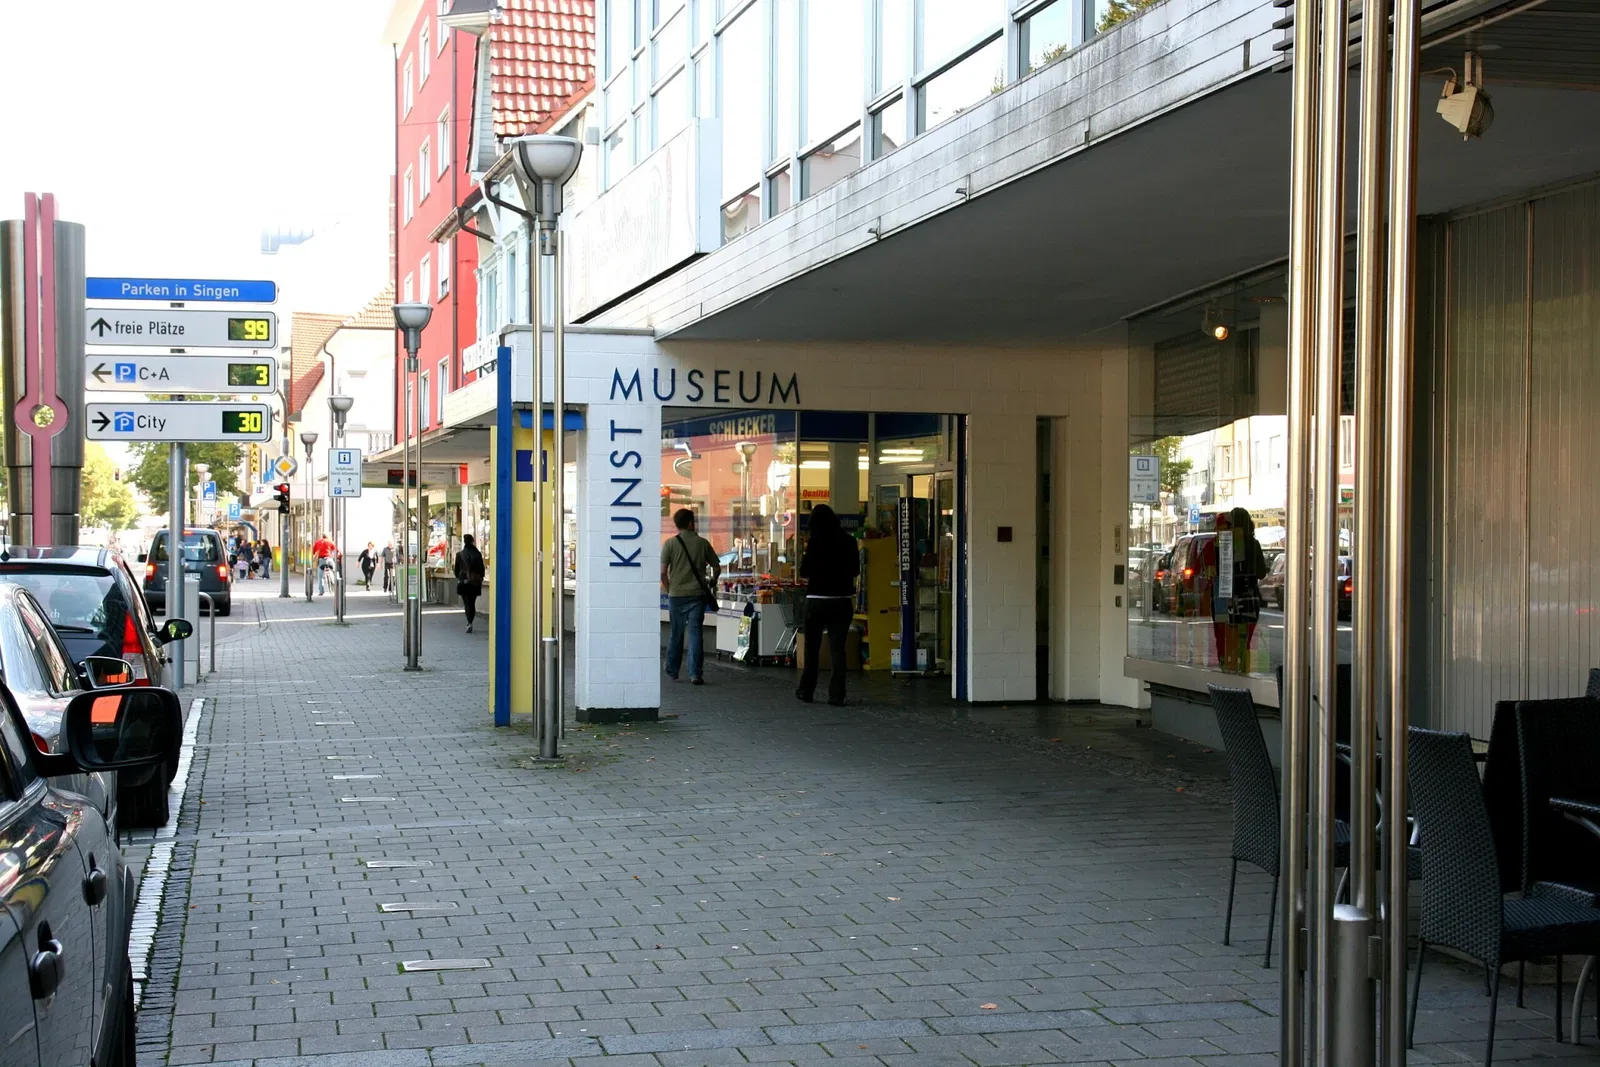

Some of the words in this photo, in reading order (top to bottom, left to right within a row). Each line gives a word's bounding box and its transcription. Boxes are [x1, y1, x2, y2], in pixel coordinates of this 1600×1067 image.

[121, 282, 170, 296] Parken
[175, 283, 187, 296] in
[193, 284, 239, 300] Singen
[115, 320, 143, 335] freie
[149, 321, 185, 335] Plätze
[244, 320, 268, 340] 99
[139, 367, 170, 381] C+A
[255, 366, 268, 385] 3
[609, 367, 801, 405] MUSEUM
[137, 415, 167, 432] City
[238, 413, 262, 432] 30
[709, 413, 776, 443] SCHLECKER
[609, 419, 643, 567] KUNST
[901, 502, 911, 571] SCHLECKER
[901, 581, 909, 605] aktuell
